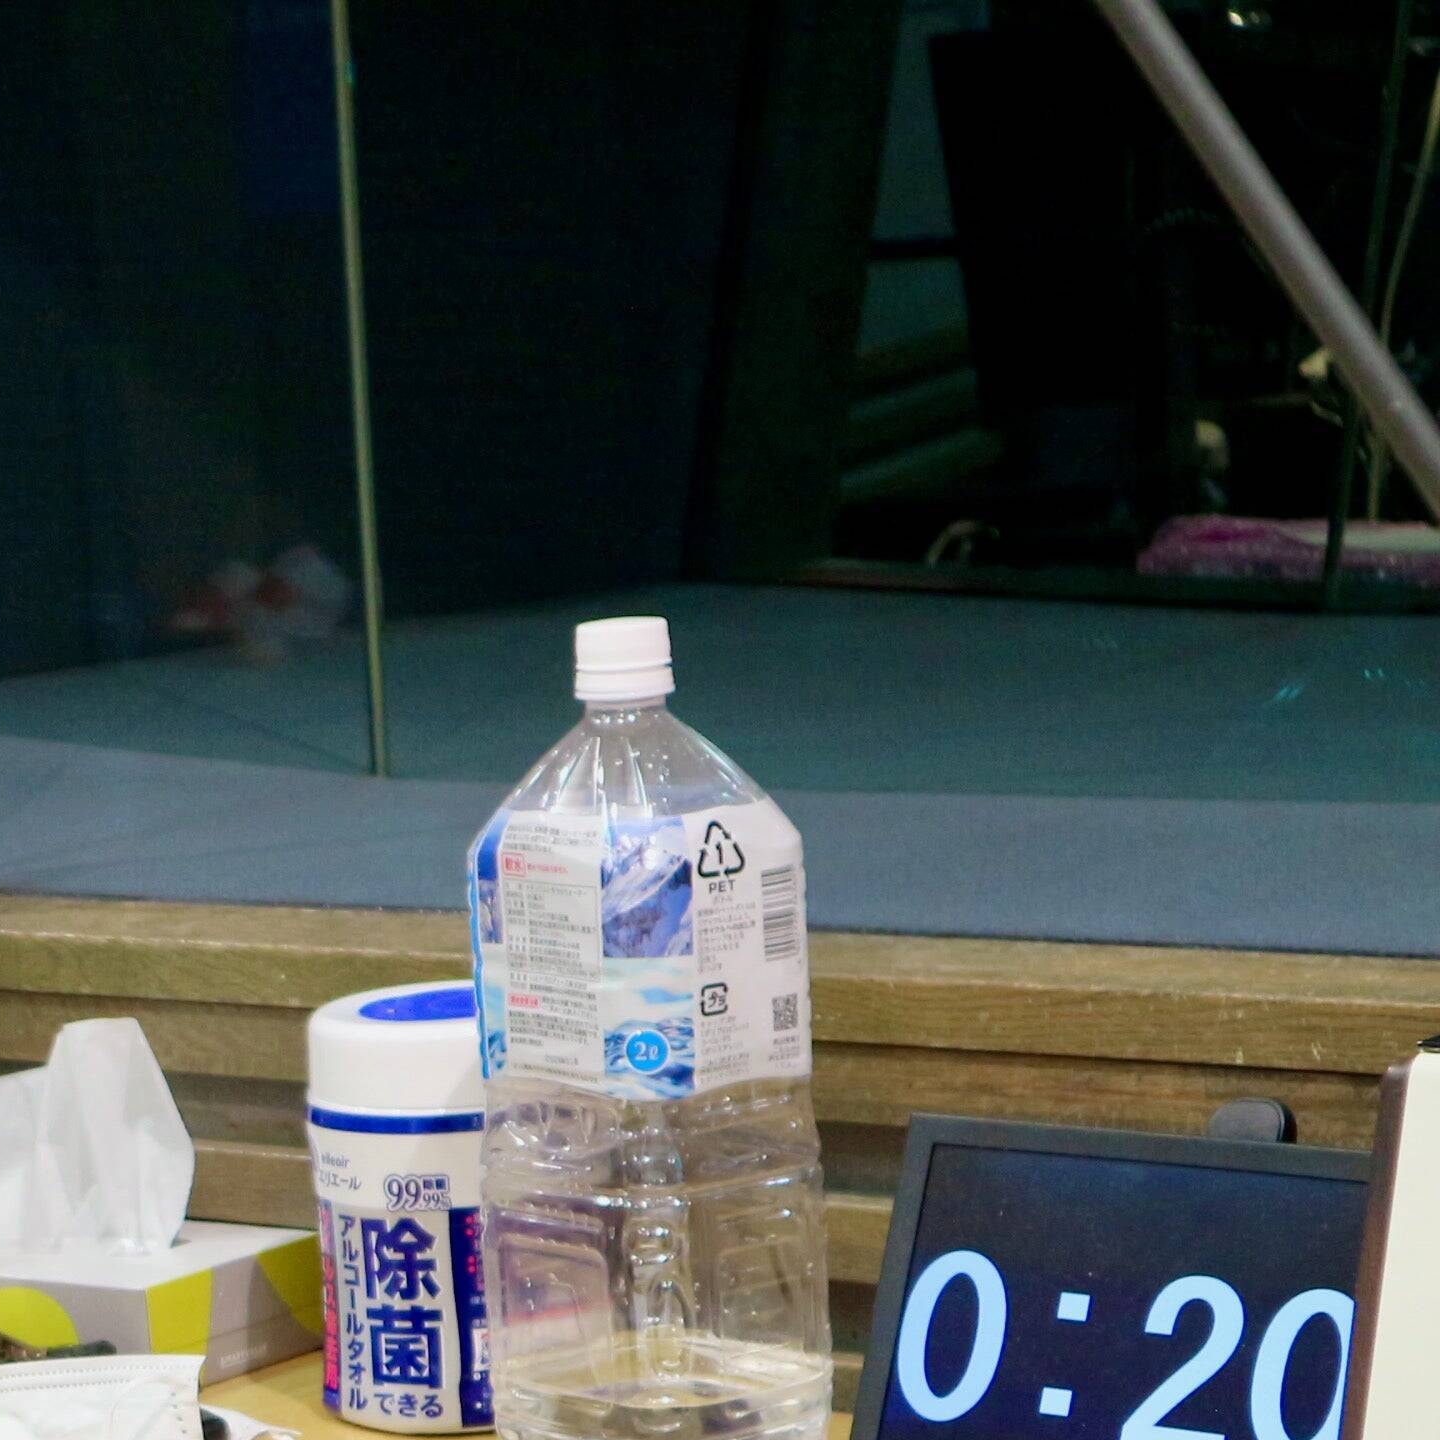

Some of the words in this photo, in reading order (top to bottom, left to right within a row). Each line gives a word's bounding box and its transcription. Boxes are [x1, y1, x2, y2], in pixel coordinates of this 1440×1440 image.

[708, 879, 736, 895] PET
[319, 1171, 362, 1191] エリエール
[338, 1213, 368, 1411] アルコールタオル
[360, 1217, 444, 1389] 除菌
[374, 1392, 444, 1418] できる
